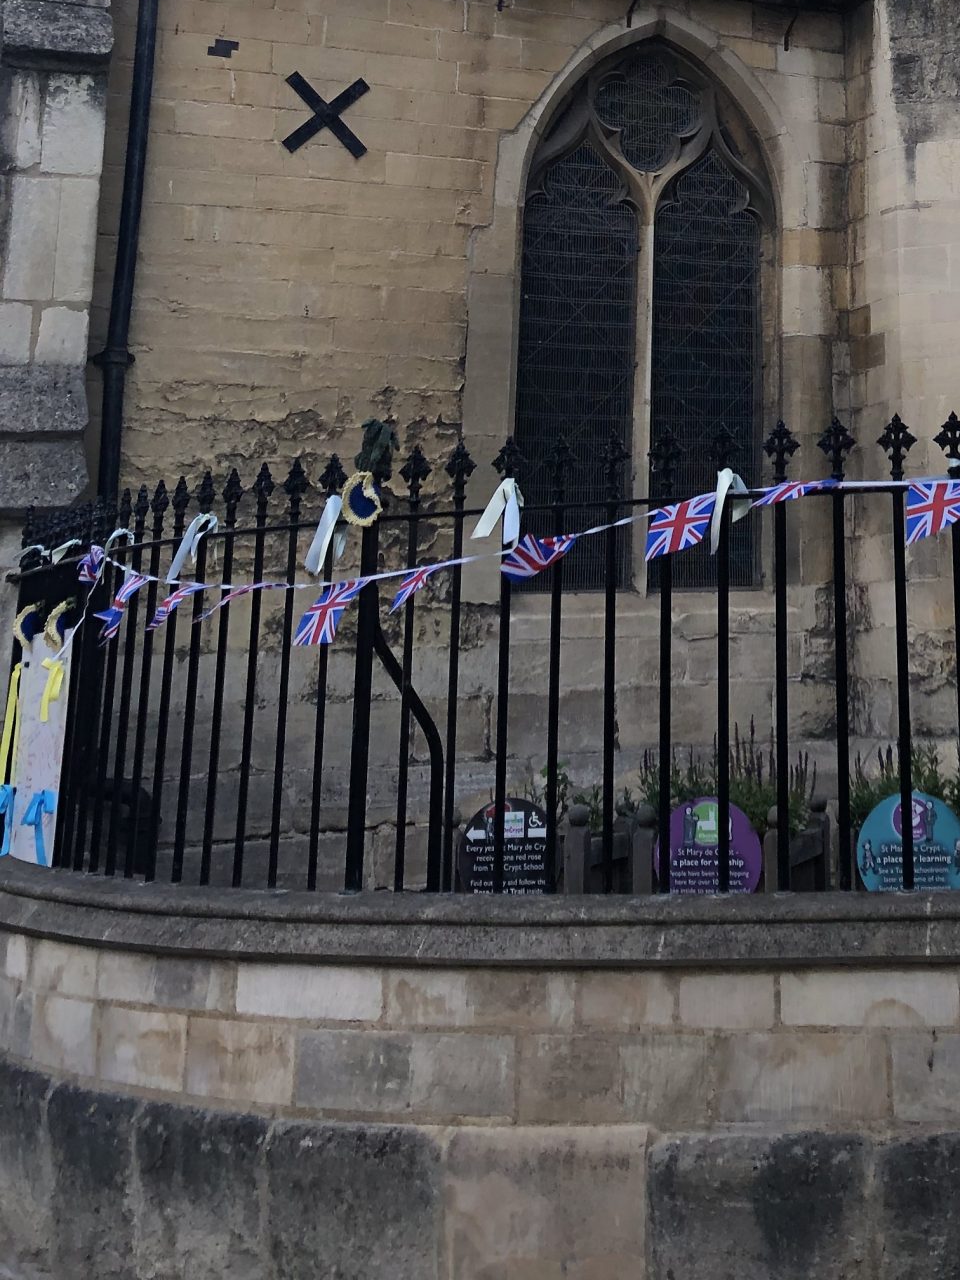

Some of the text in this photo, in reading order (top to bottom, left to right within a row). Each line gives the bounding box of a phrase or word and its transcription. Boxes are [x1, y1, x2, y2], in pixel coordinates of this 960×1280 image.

[466, 845, 482, 853] Every
[508, 844, 522, 852] Mary
[534, 844, 546, 852] Cry
[687, 849, 702, 857] Mary
[921, 844, 940, 854] Crypt
[680, 859, 699, 868] place
[883, 856, 903, 865] place
[920, 855, 951, 864] learning
[504, 864, 522, 872] Crypt
